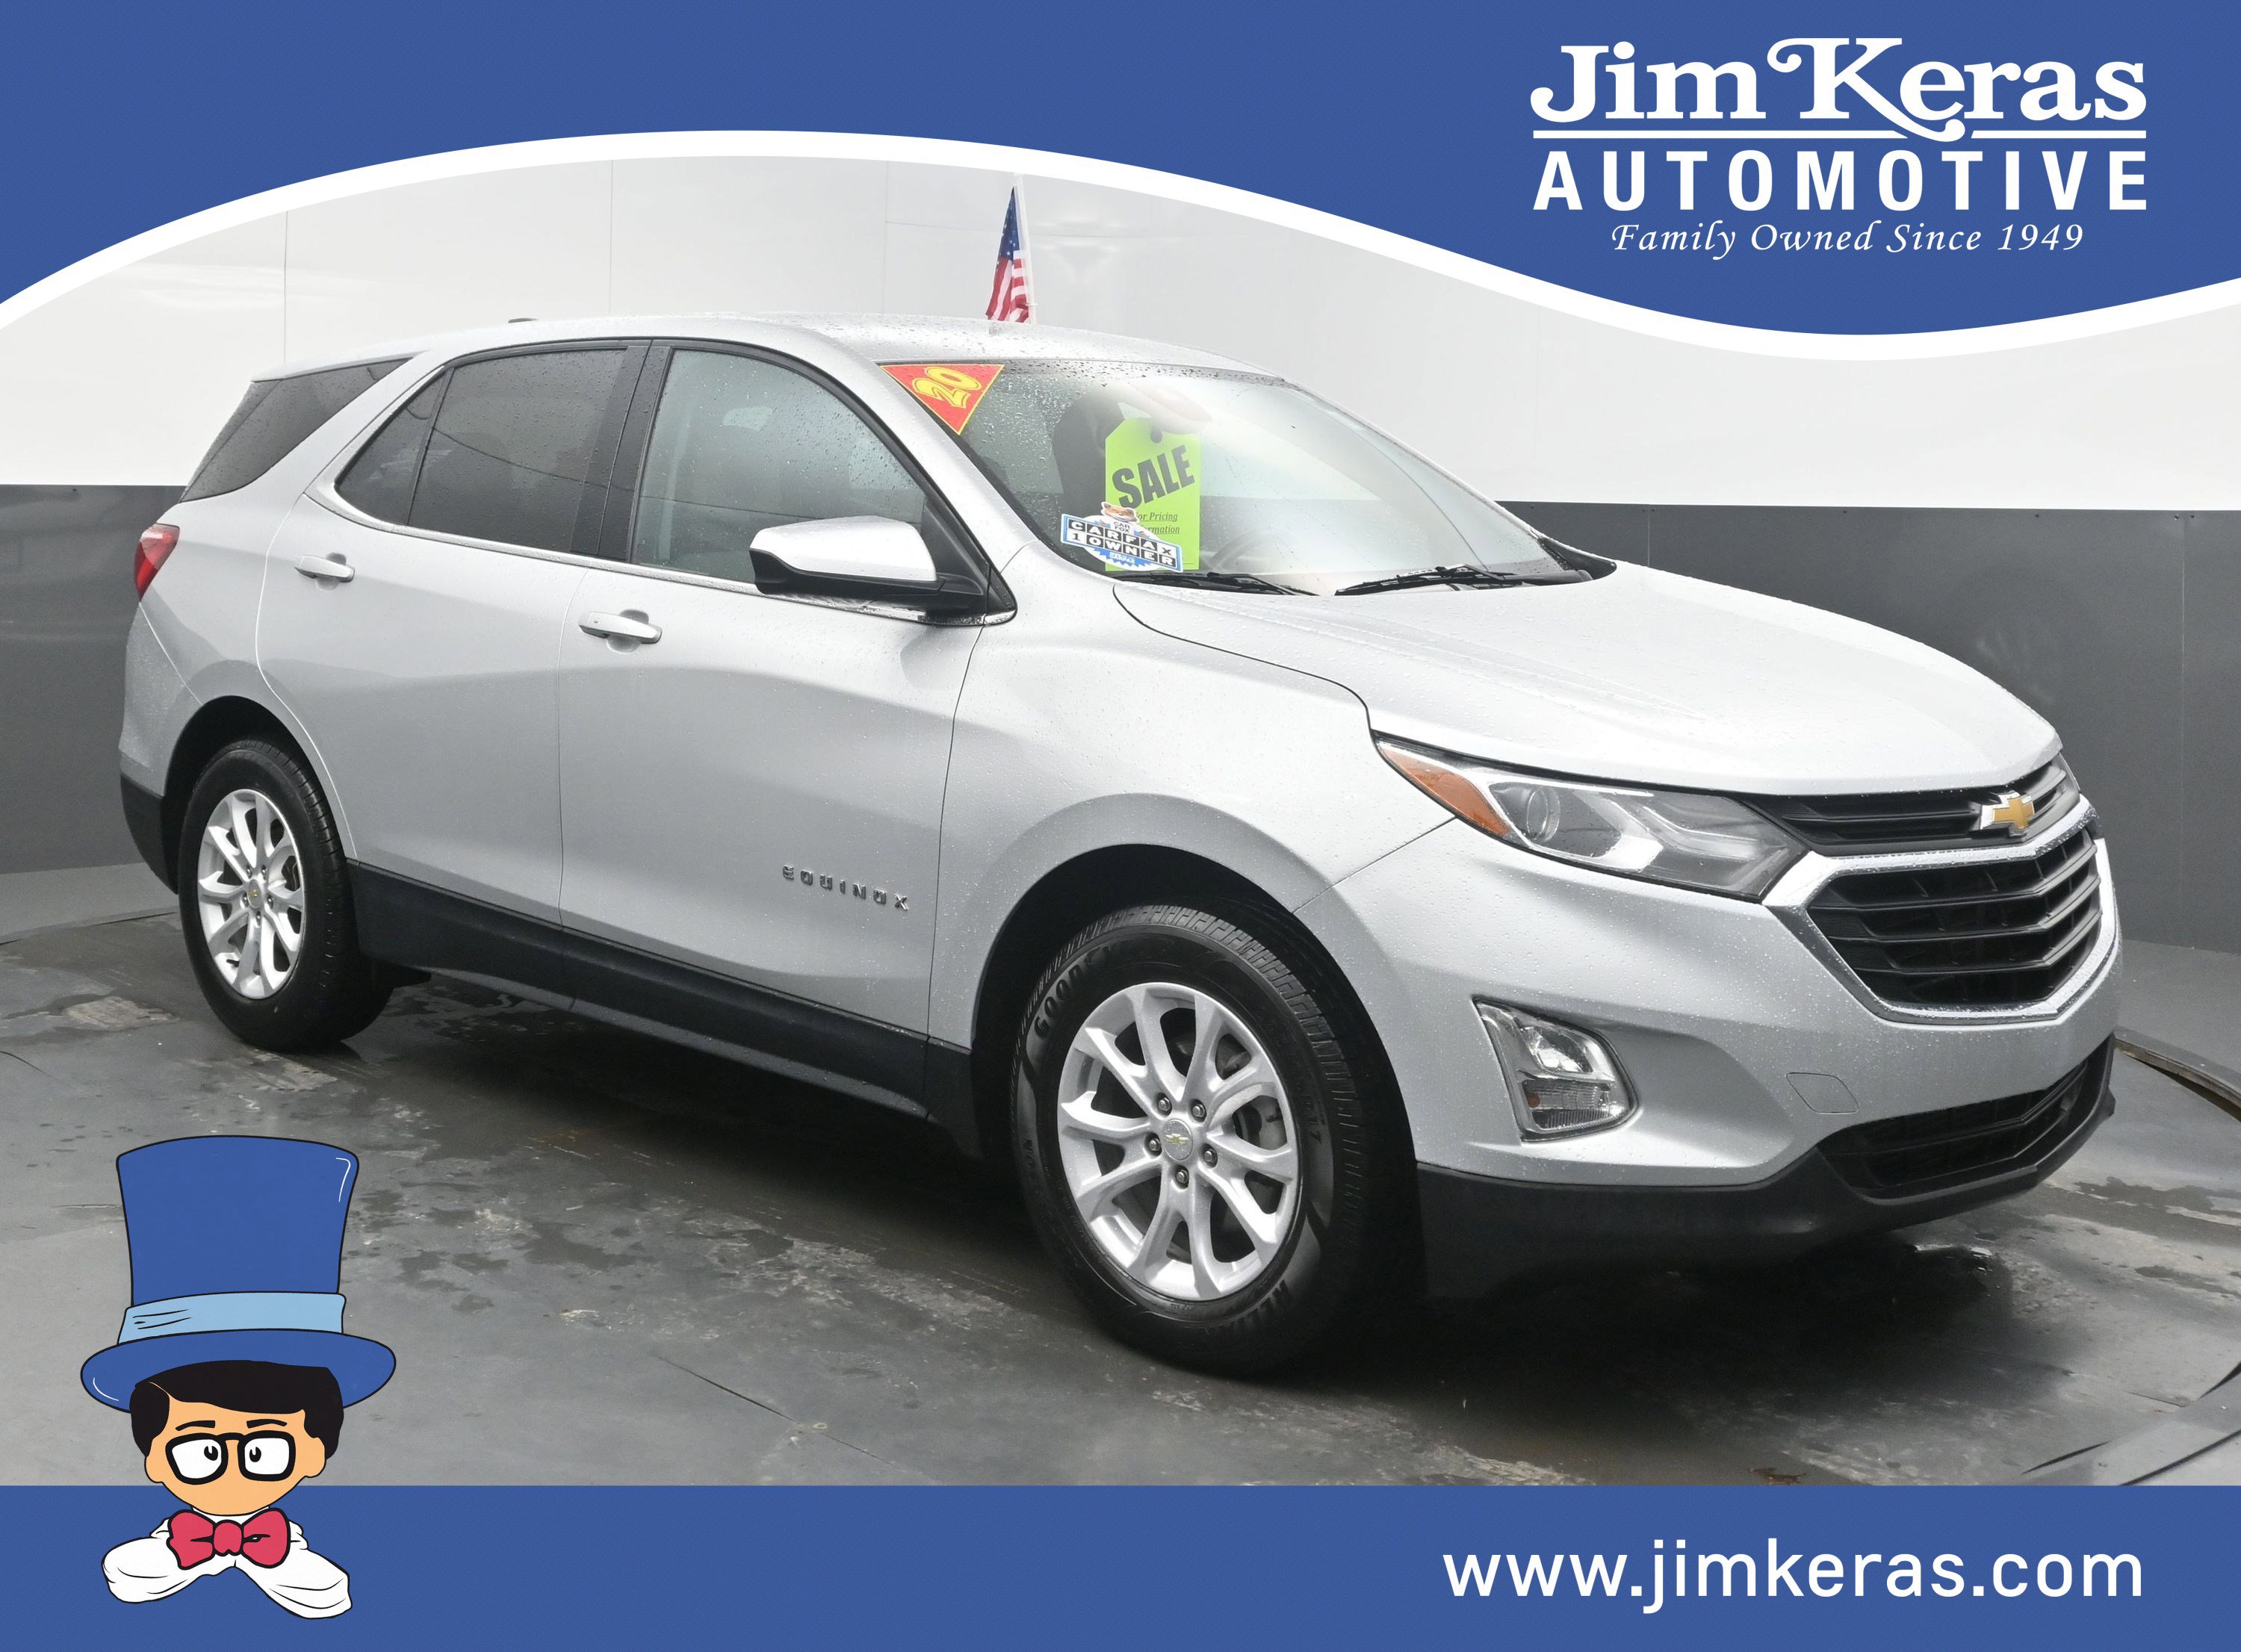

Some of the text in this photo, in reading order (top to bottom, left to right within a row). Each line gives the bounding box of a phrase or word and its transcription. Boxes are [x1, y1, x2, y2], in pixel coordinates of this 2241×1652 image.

[911, 366, 982, 409] 20
[1112, 444, 1195, 509] SALE
[1150, 512, 1178, 522] Pricing
[1071, 521, 1172, 556] CARFAX
[1072, 532, 1082, 541] 1
[1088, 536, 1174, 566] OWNER
[782, 864, 909, 911] EQUINOX
